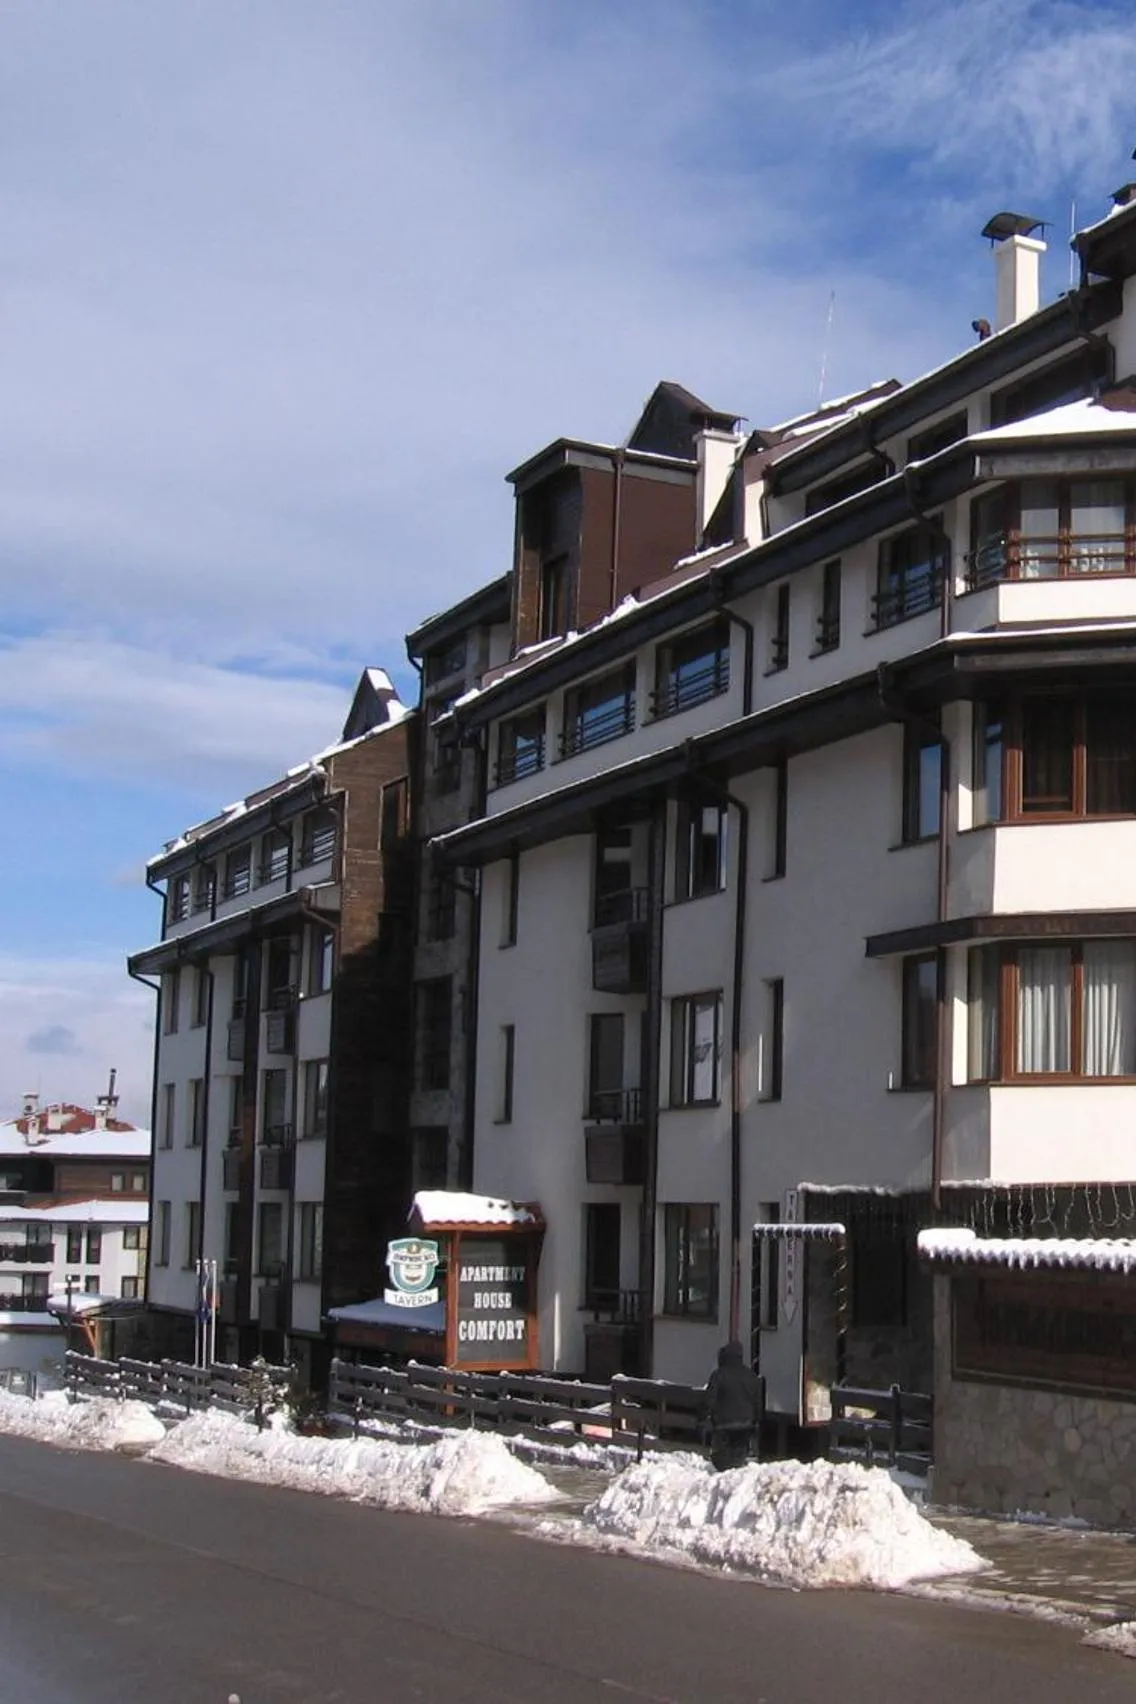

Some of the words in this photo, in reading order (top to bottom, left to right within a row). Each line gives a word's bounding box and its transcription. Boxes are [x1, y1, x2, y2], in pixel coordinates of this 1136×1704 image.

[460, 1266, 525, 1282] APARTMENT
[393, 1293, 433, 1306] TAVERN
[474, 1292, 512, 1309] HOUSE
[459, 1320, 525, 1341] COMFORT
